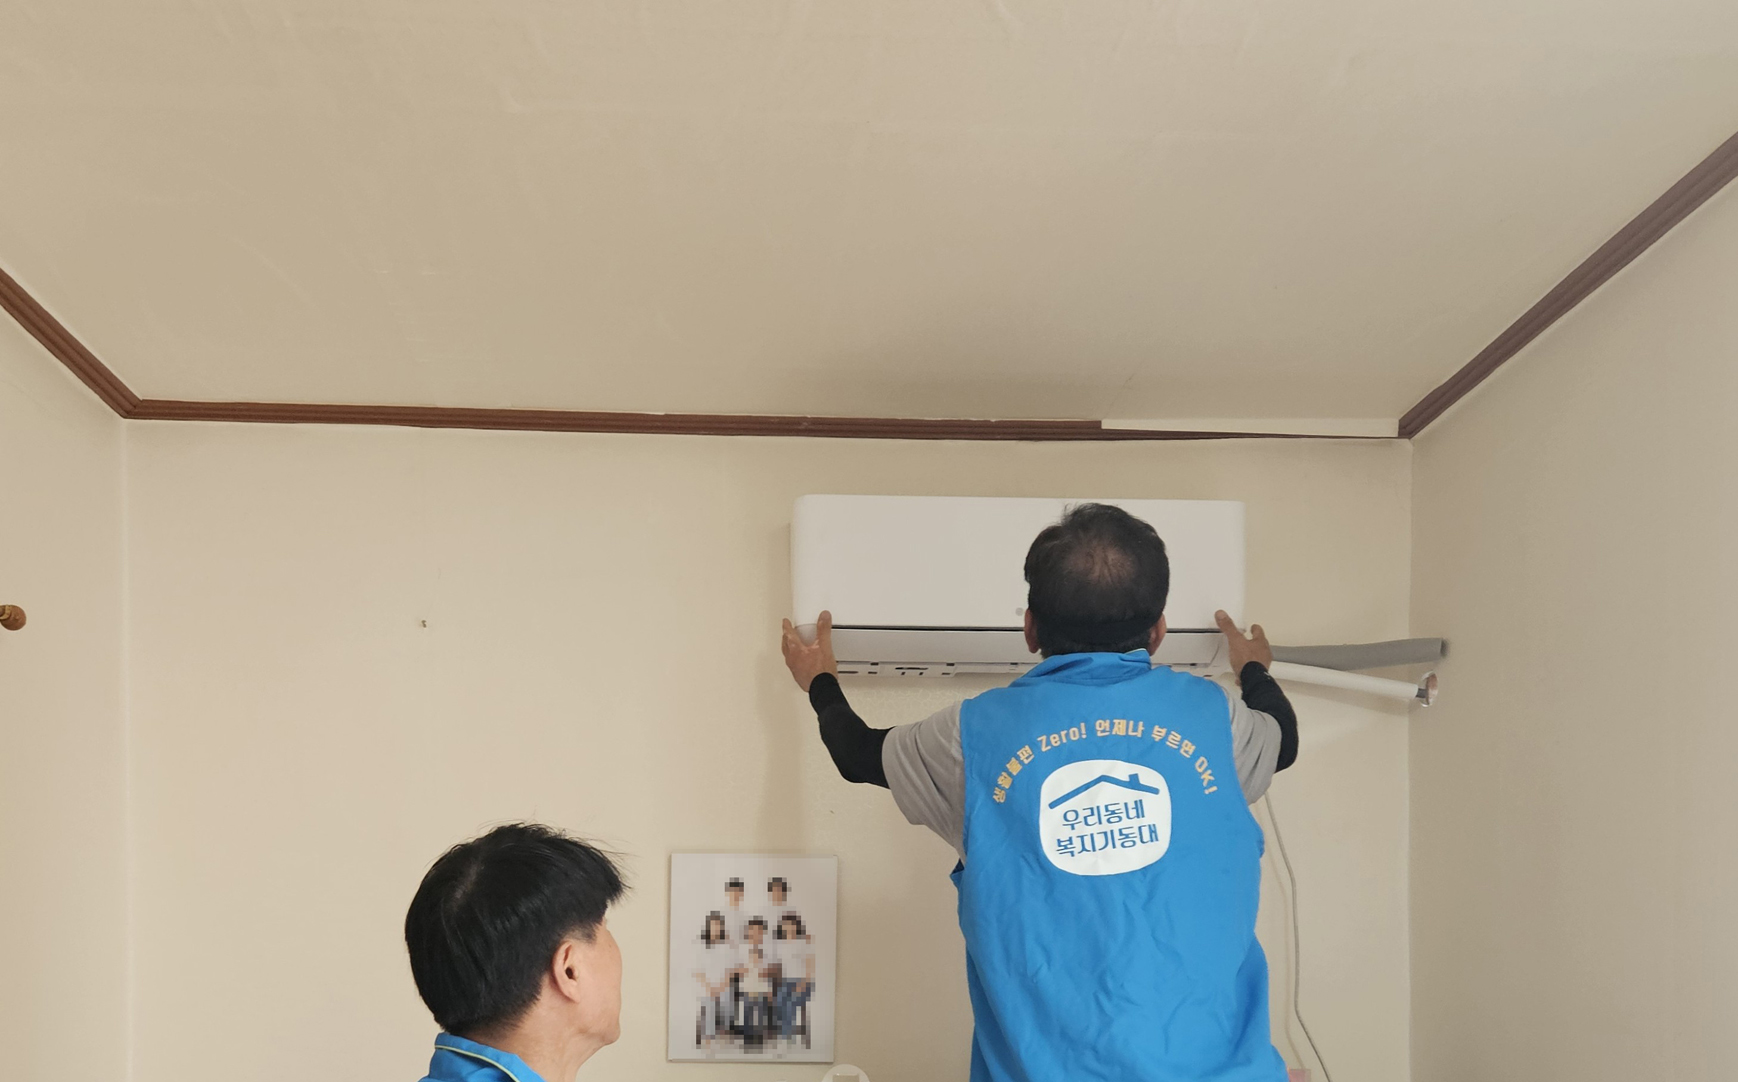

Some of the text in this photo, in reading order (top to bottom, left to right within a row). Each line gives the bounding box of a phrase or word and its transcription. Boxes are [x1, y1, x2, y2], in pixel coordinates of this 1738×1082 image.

[1037, 722, 1087, 752] Zero!
[1095, 718, 1145, 738] 언제나
[1151, 725, 1196, 758] 부르면
[1194, 756, 1218, 795] OK!
[1061, 799, 1146, 831] 우리동네
[1055, 823, 1160, 857] 복지기동대
